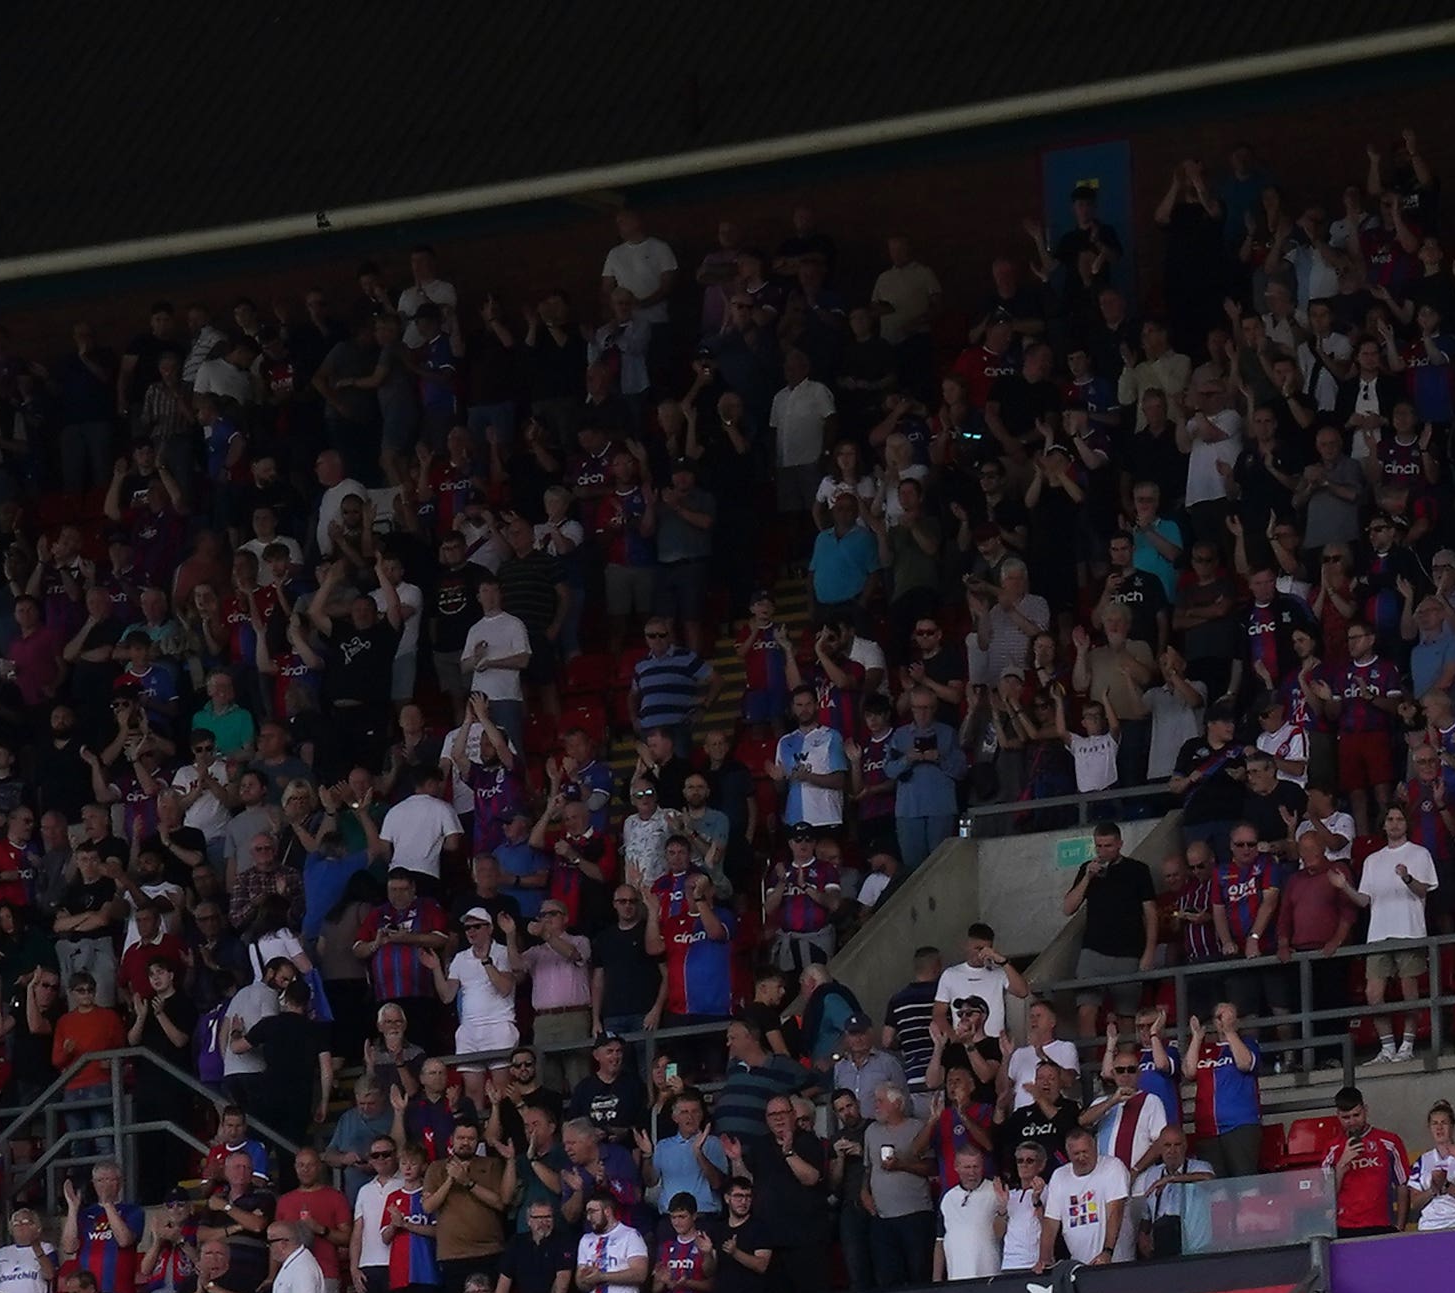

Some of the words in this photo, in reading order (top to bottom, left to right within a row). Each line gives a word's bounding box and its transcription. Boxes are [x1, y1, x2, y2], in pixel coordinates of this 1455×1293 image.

[1385, 461, 1419, 474] cinch
[577, 474, 604, 484] cinch
[440, 480, 471, 492] cinch
[1249, 622, 1275, 635] cinc
[674, 932, 705, 942] cinch
[1197, 1058, 1233, 1068] cinch
[89, 1230, 112, 1240] W88
[668, 1259, 694, 1269] cinch
